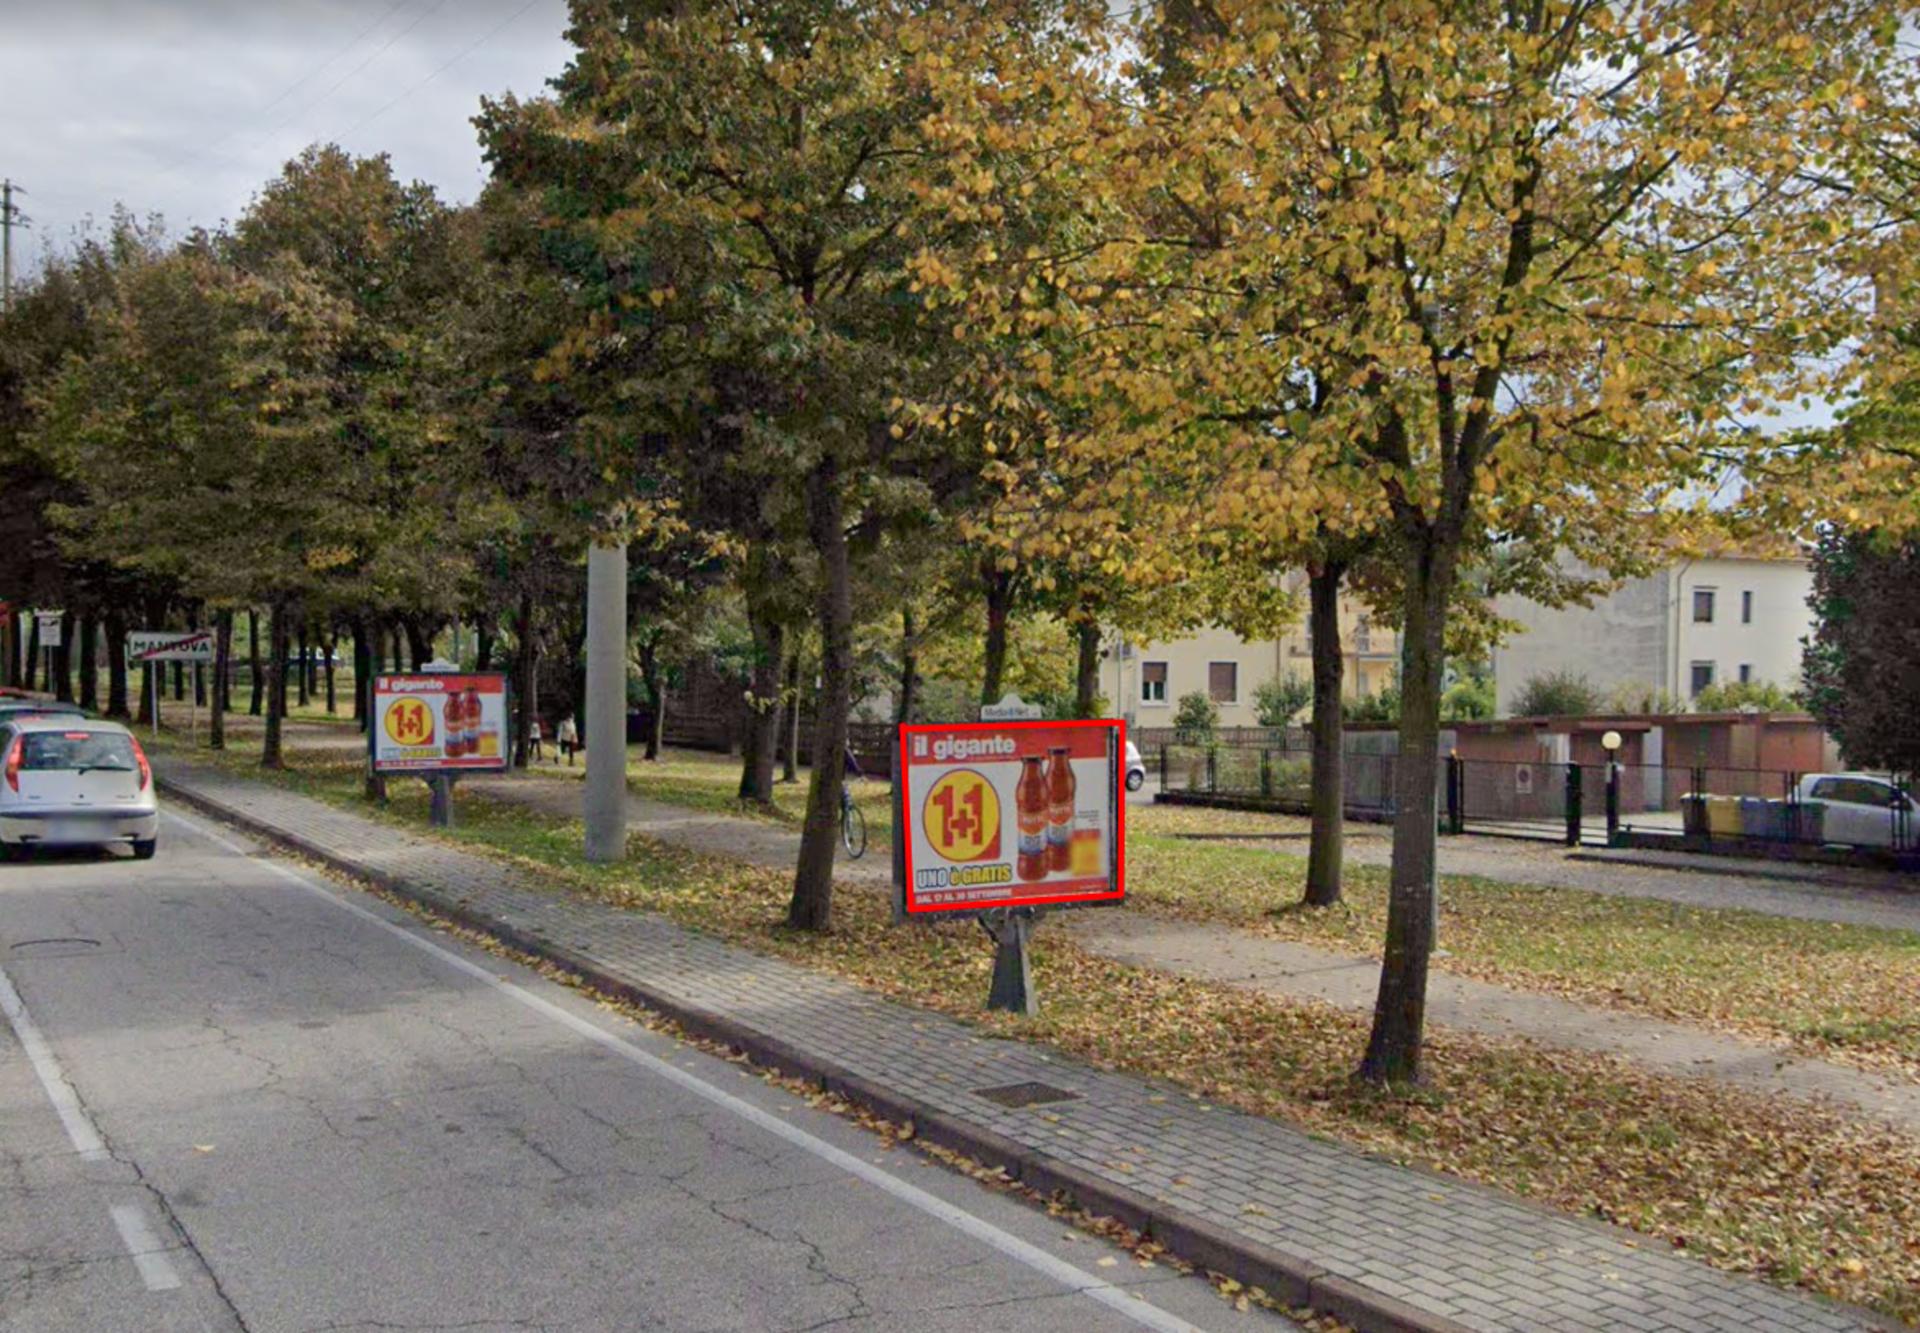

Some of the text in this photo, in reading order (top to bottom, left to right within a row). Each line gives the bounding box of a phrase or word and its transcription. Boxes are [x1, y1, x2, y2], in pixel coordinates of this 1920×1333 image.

[133, 640, 209, 652] MANTOVA
[914, 735, 1016, 760] il gigante
[932, 784, 984, 849] 1+1
[917, 868, 948, 889] UNO
[961, 863, 1012, 885] GRATIS
